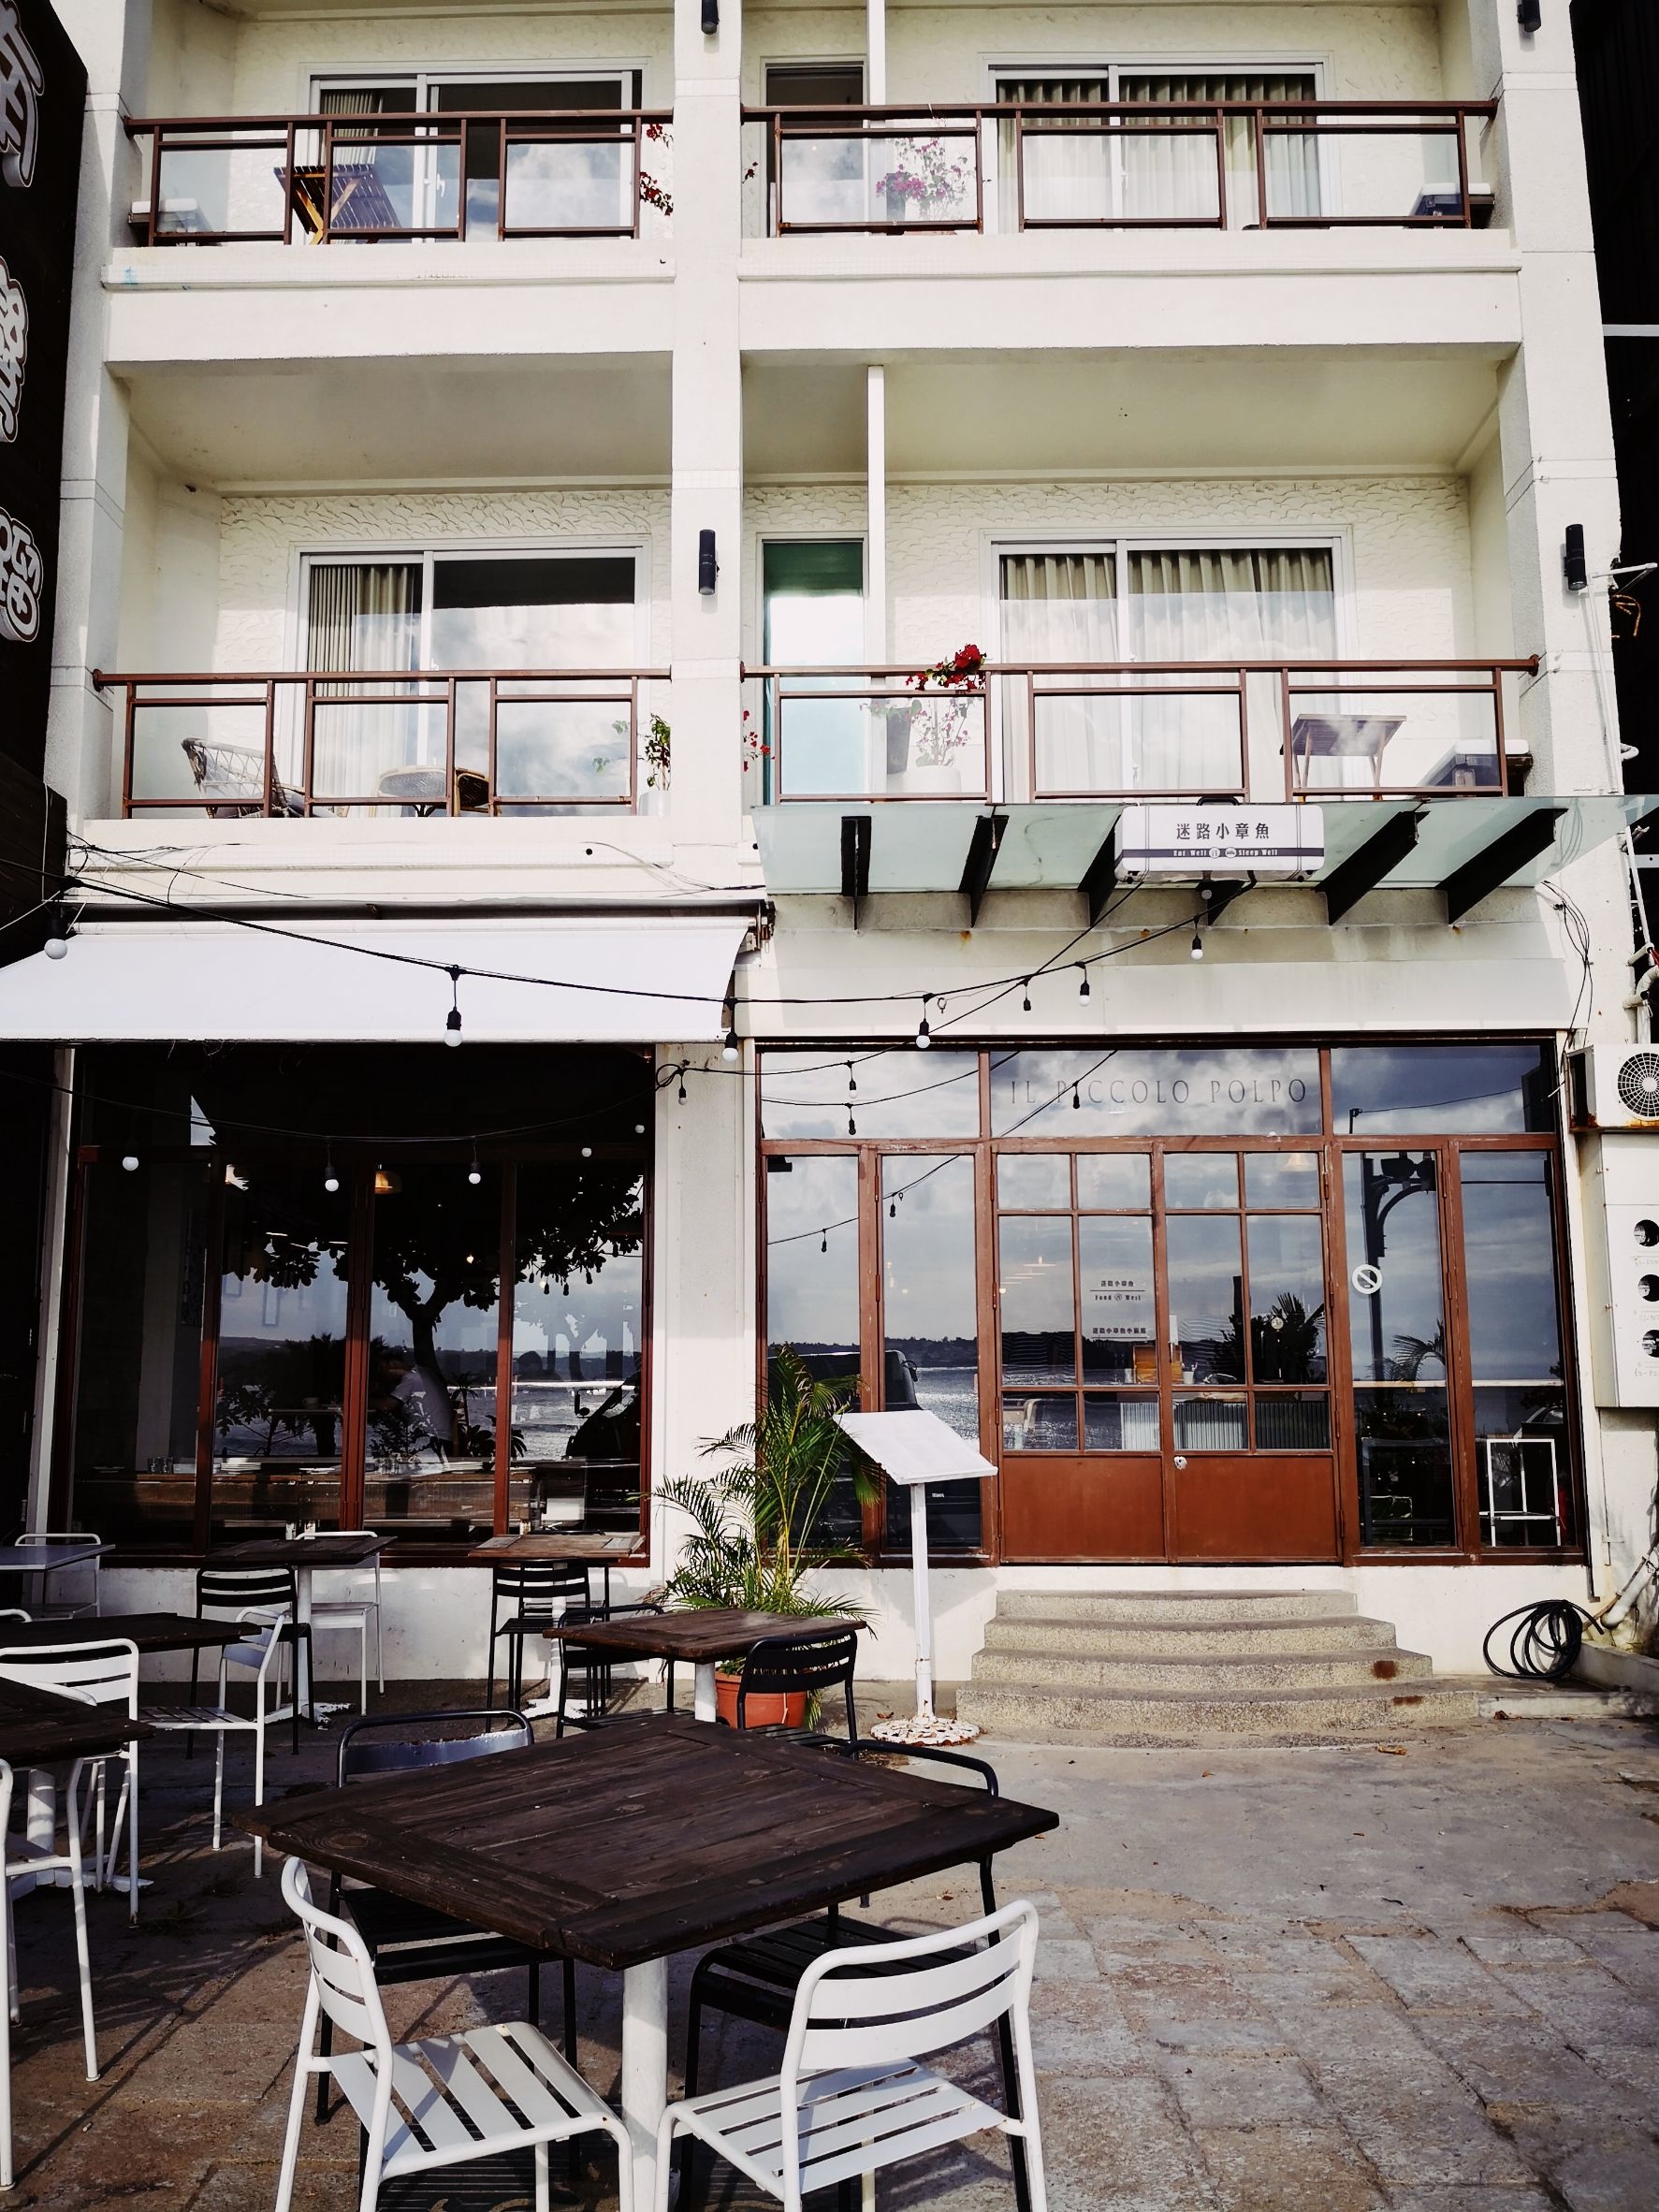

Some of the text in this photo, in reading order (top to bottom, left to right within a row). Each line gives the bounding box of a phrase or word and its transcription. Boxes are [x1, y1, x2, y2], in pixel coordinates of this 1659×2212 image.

[1176, 822, 1270, 840] 迷路小章魚
[1011, 1078, 1306, 1104] IL PCCOLO POLPO
